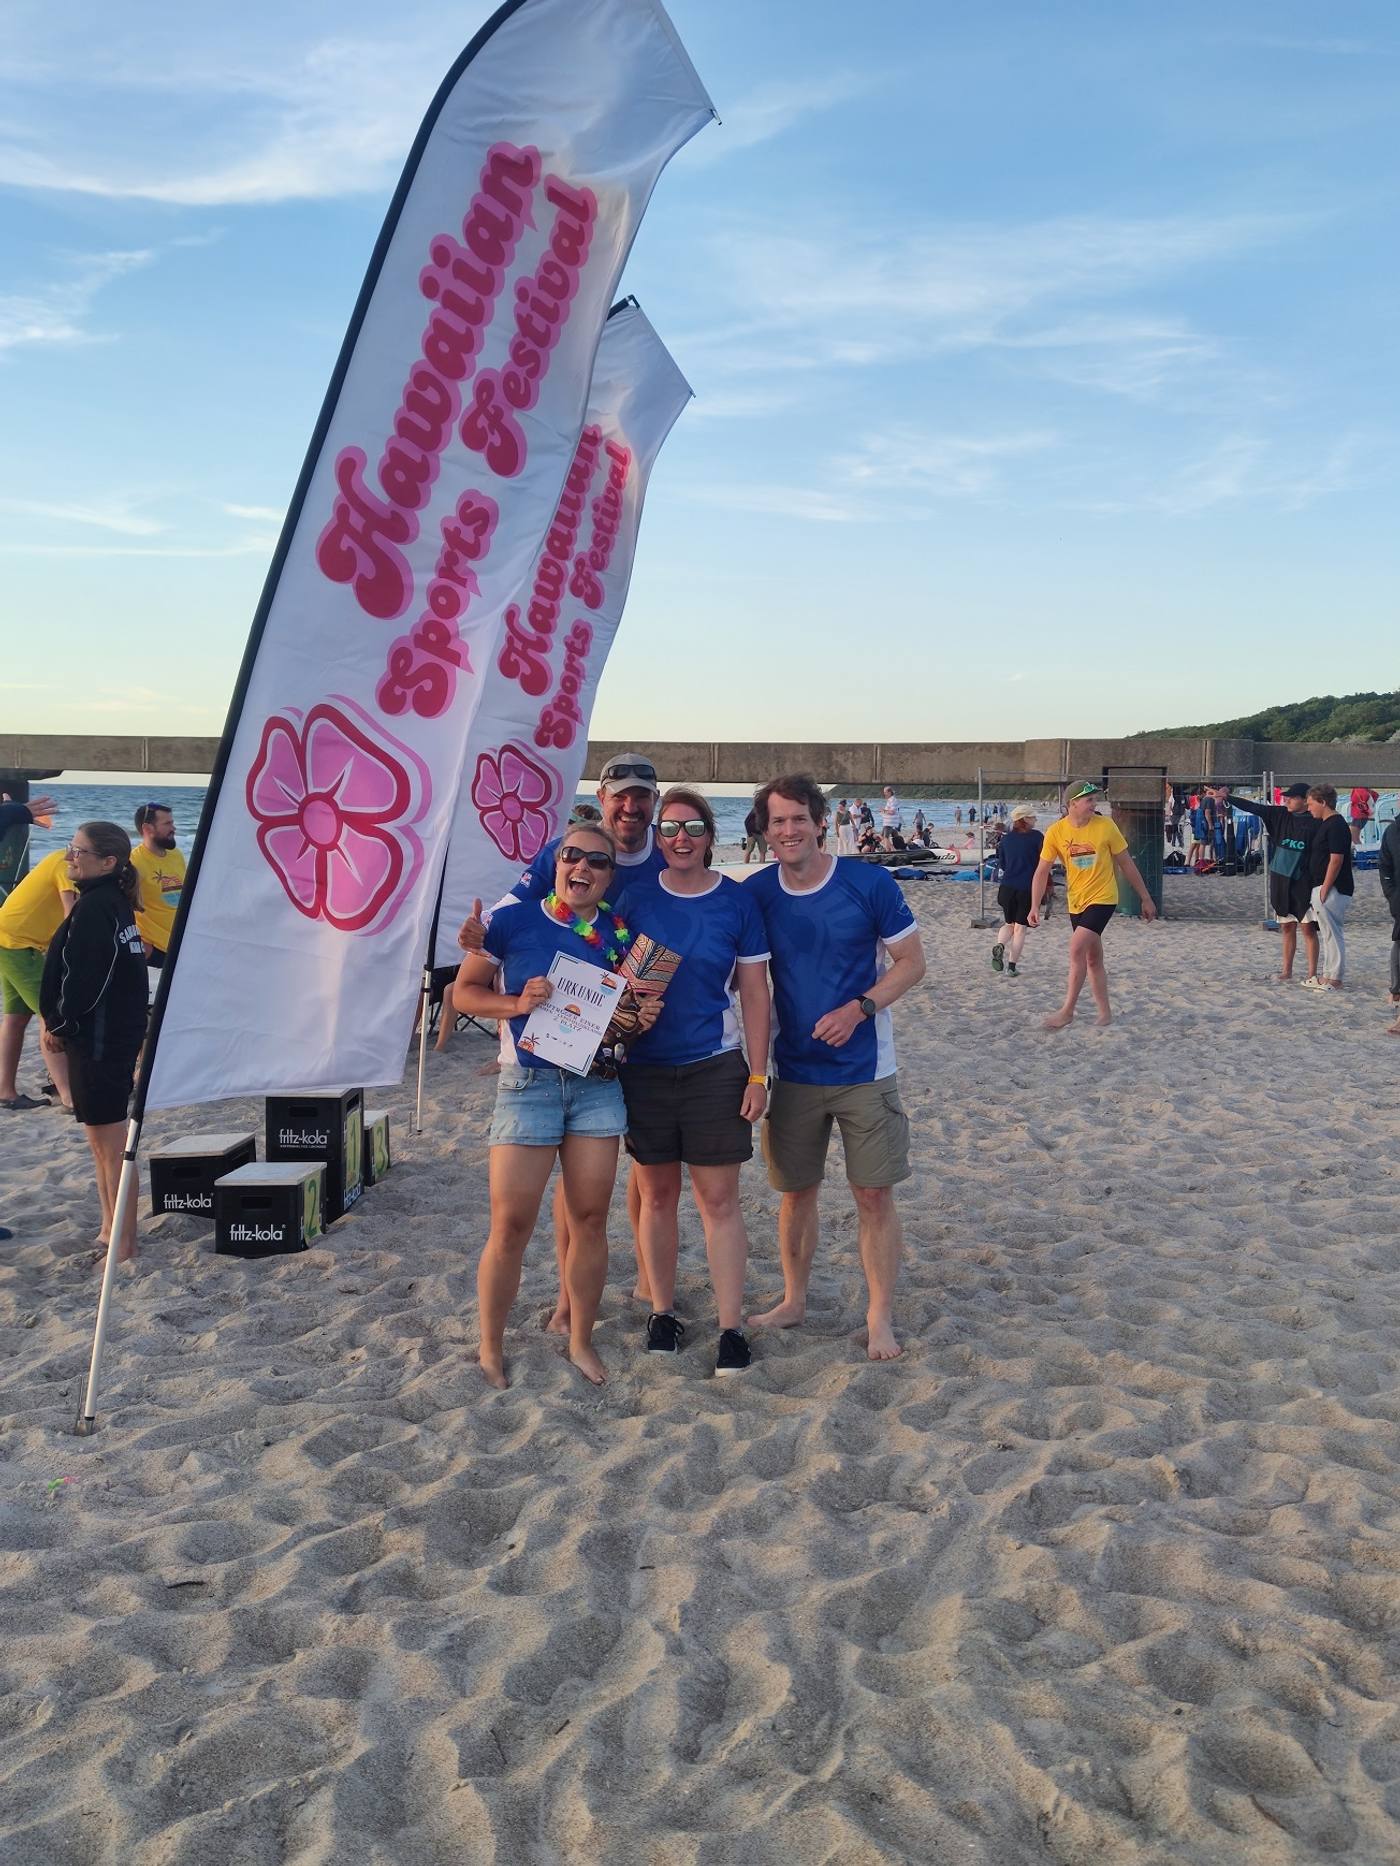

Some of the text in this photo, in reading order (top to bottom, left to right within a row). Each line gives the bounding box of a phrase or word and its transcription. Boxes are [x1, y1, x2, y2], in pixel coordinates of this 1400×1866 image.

[316, 141, 543, 620] Hawaiian
[376, 173, 598, 719] Sports Festival
[534, 439, 631, 749] Sports Festival
[557, 977, 605, 1007] URKUNDE
[279, 1129, 329, 1145] fritz-kola
[376, 1126, 386, 1177] 3
[163, 1193, 212, 1209] fritz-kola
[305, 1179, 318, 1240] 2
[229, 1224, 283, 1241] fritz-kola
